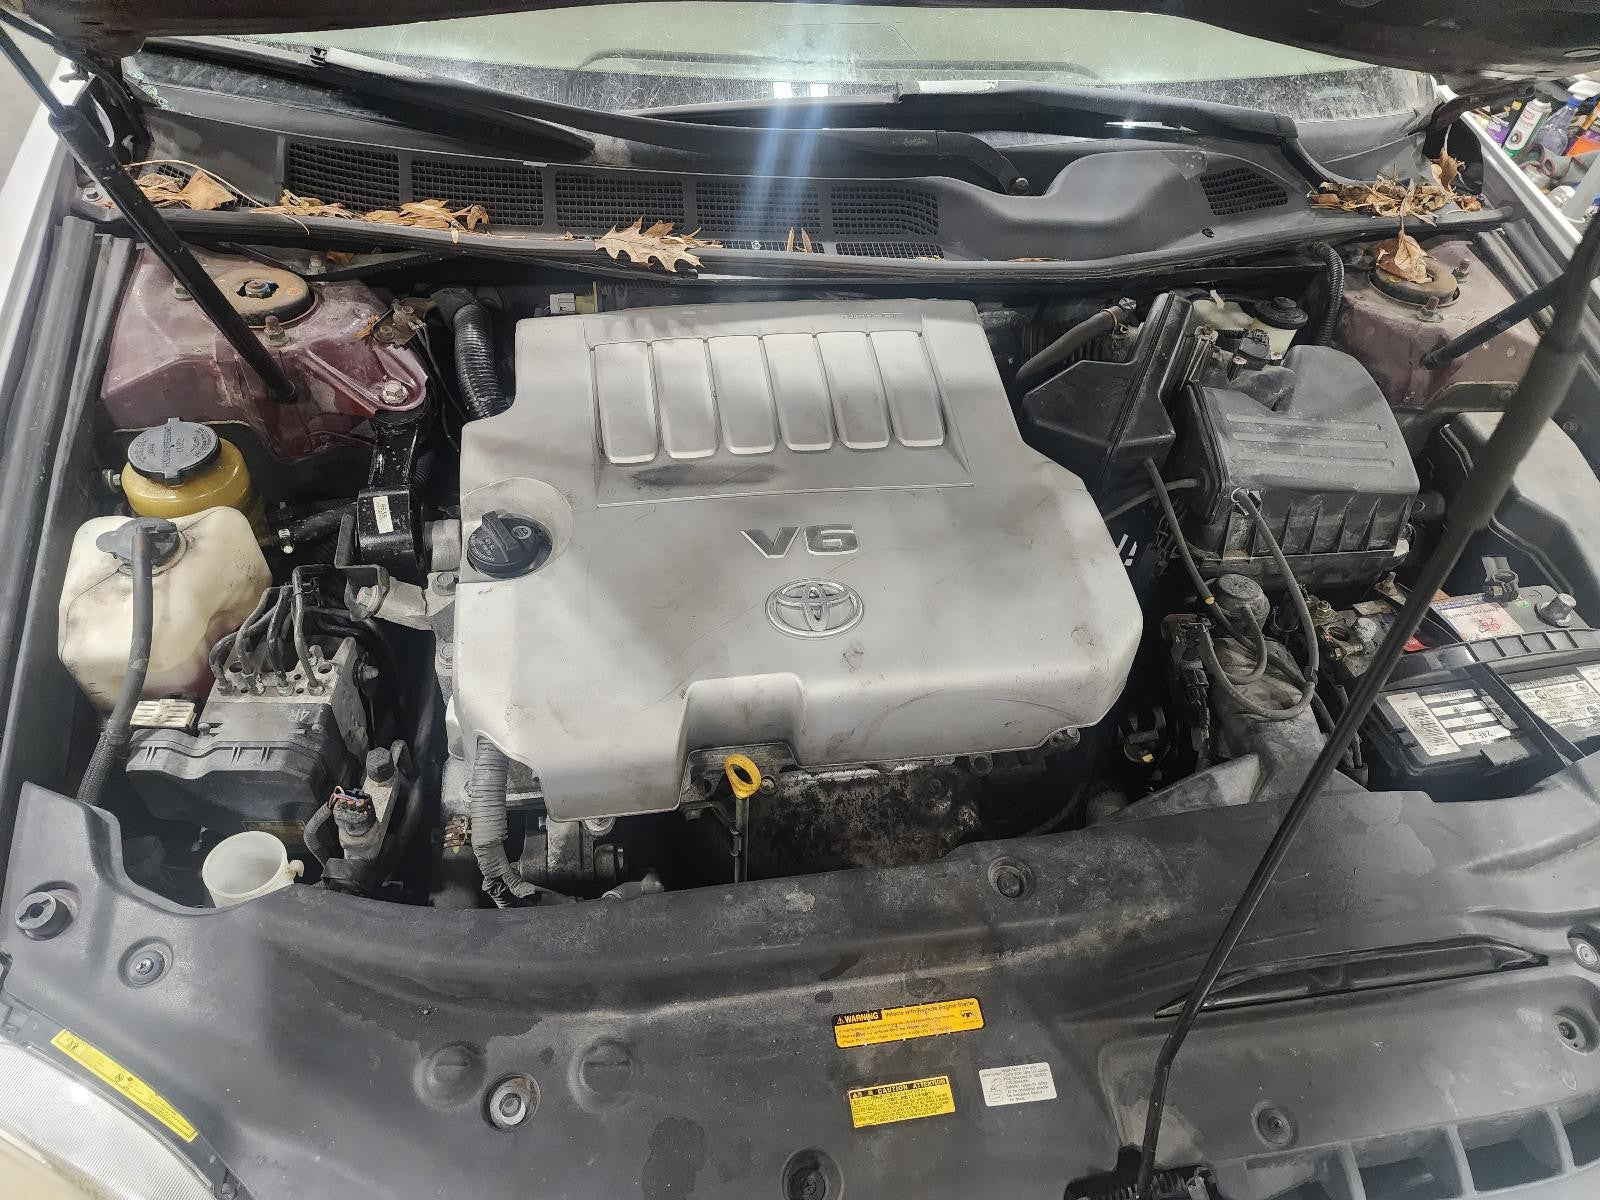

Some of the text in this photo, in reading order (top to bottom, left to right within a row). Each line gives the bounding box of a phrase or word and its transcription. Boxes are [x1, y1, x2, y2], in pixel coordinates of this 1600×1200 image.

[739, 524, 860, 559] V6
[844, 1012, 879, 1023] WARNING
[877, 1078, 946, 1095] CAUTION ATTENTION
